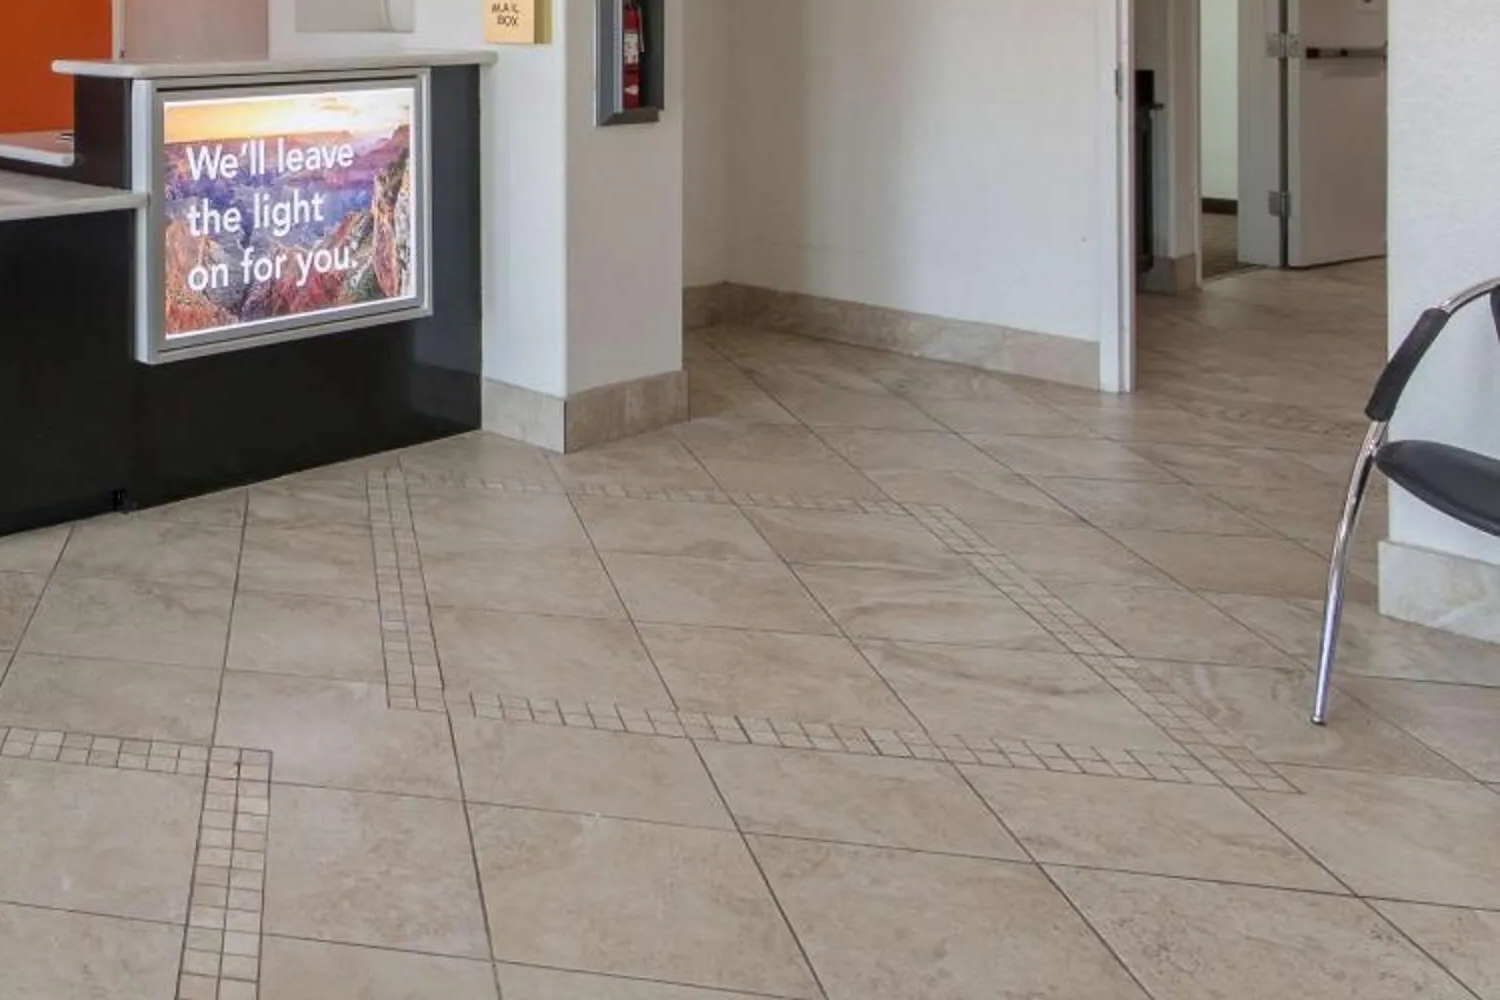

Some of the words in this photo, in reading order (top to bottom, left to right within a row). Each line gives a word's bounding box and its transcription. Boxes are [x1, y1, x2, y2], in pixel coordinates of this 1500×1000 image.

[186, 139, 265, 181] We'll
[277, 137, 354, 173] leave
[187, 197, 241, 237] the
[253, 189, 325, 237] light
[187, 261, 229, 291] on
[240, 246, 287, 285] for
